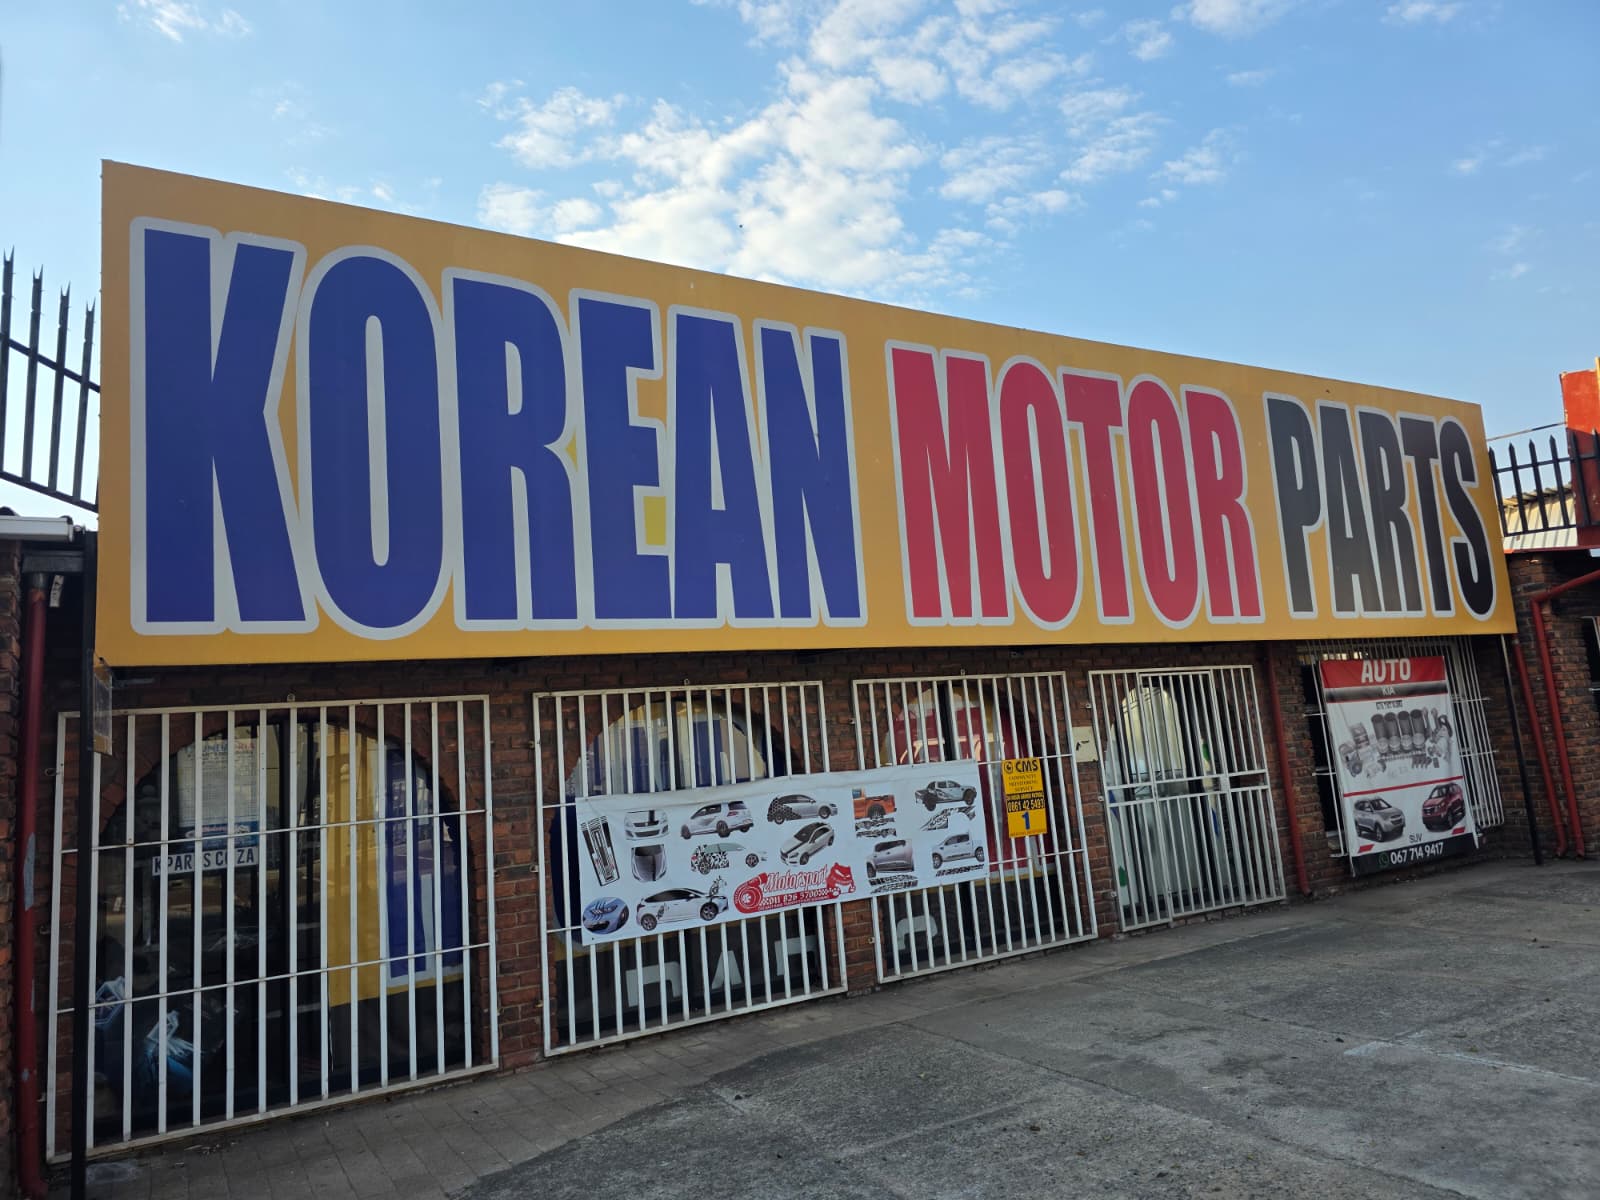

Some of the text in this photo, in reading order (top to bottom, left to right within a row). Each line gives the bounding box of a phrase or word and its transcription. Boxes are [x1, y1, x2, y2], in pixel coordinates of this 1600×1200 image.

[135, 219, 1496, 636] KOREAN MOTOR PARTS
[1361, 657, 1411, 684] AUTO
[1015, 759, 1039, 773] CMS
[1021, 811, 1031, 830] 1
[155, 852, 211, 873] KPARS
[1390, 849, 1408, 864] 067
[1424, 841, 1444, 857] 9417
[763, 864, 828, 893] Motorsport
